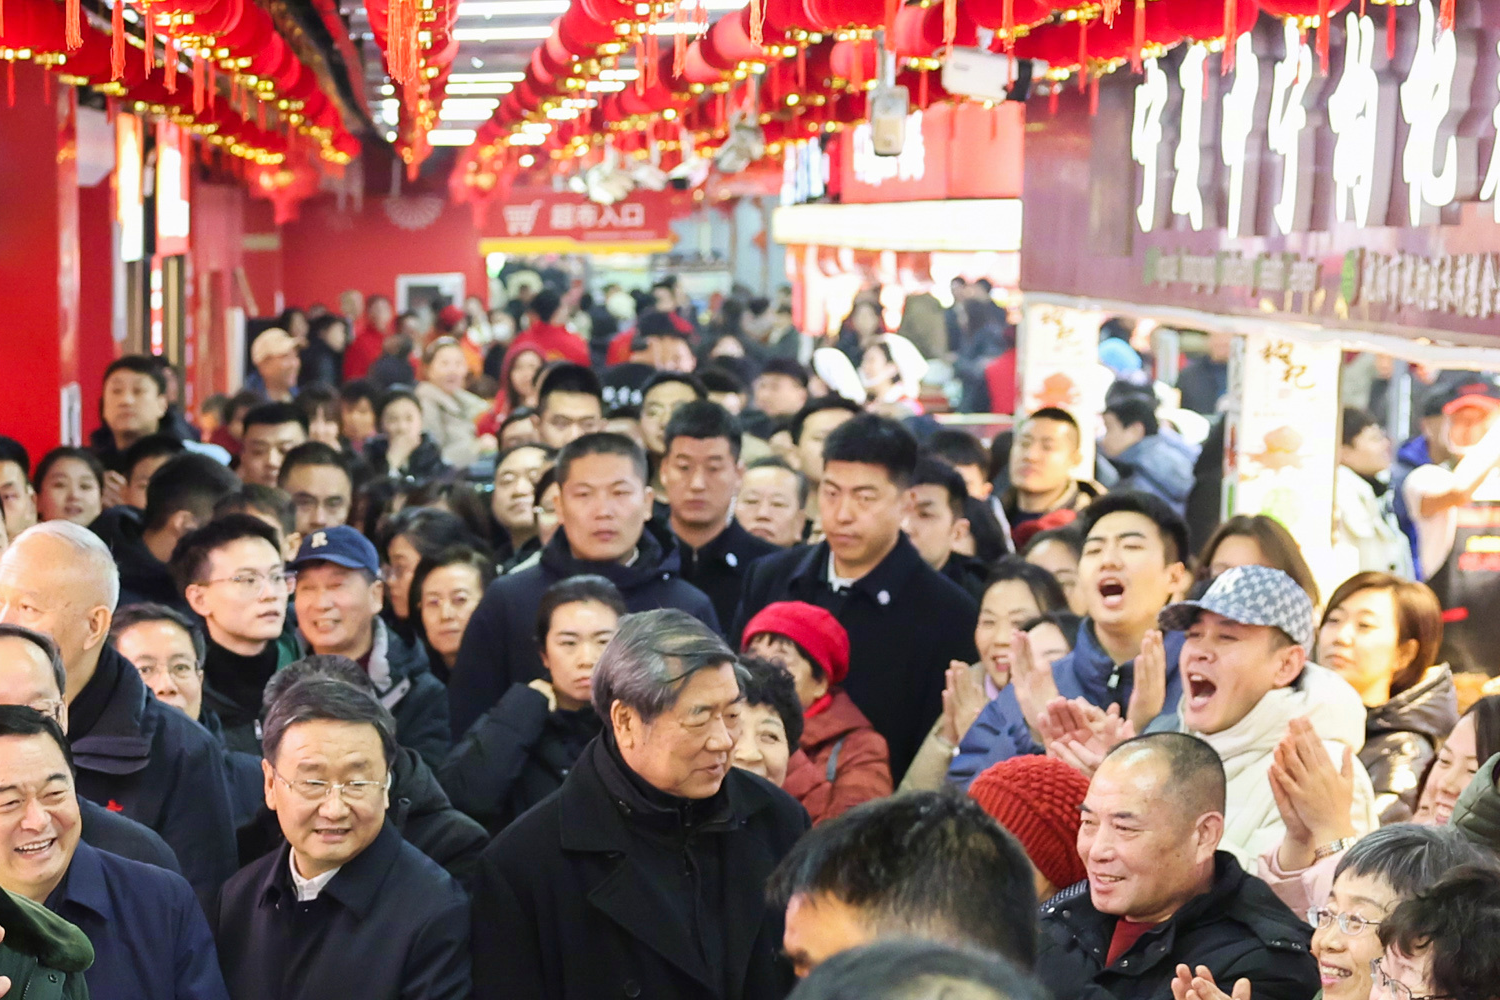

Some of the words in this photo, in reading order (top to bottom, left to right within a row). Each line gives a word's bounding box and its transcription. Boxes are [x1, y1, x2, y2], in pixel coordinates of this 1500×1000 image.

[1132, 0, 1500, 239] 宁夏中宁枸杞
[550, 203, 645, 229] 超市入口
